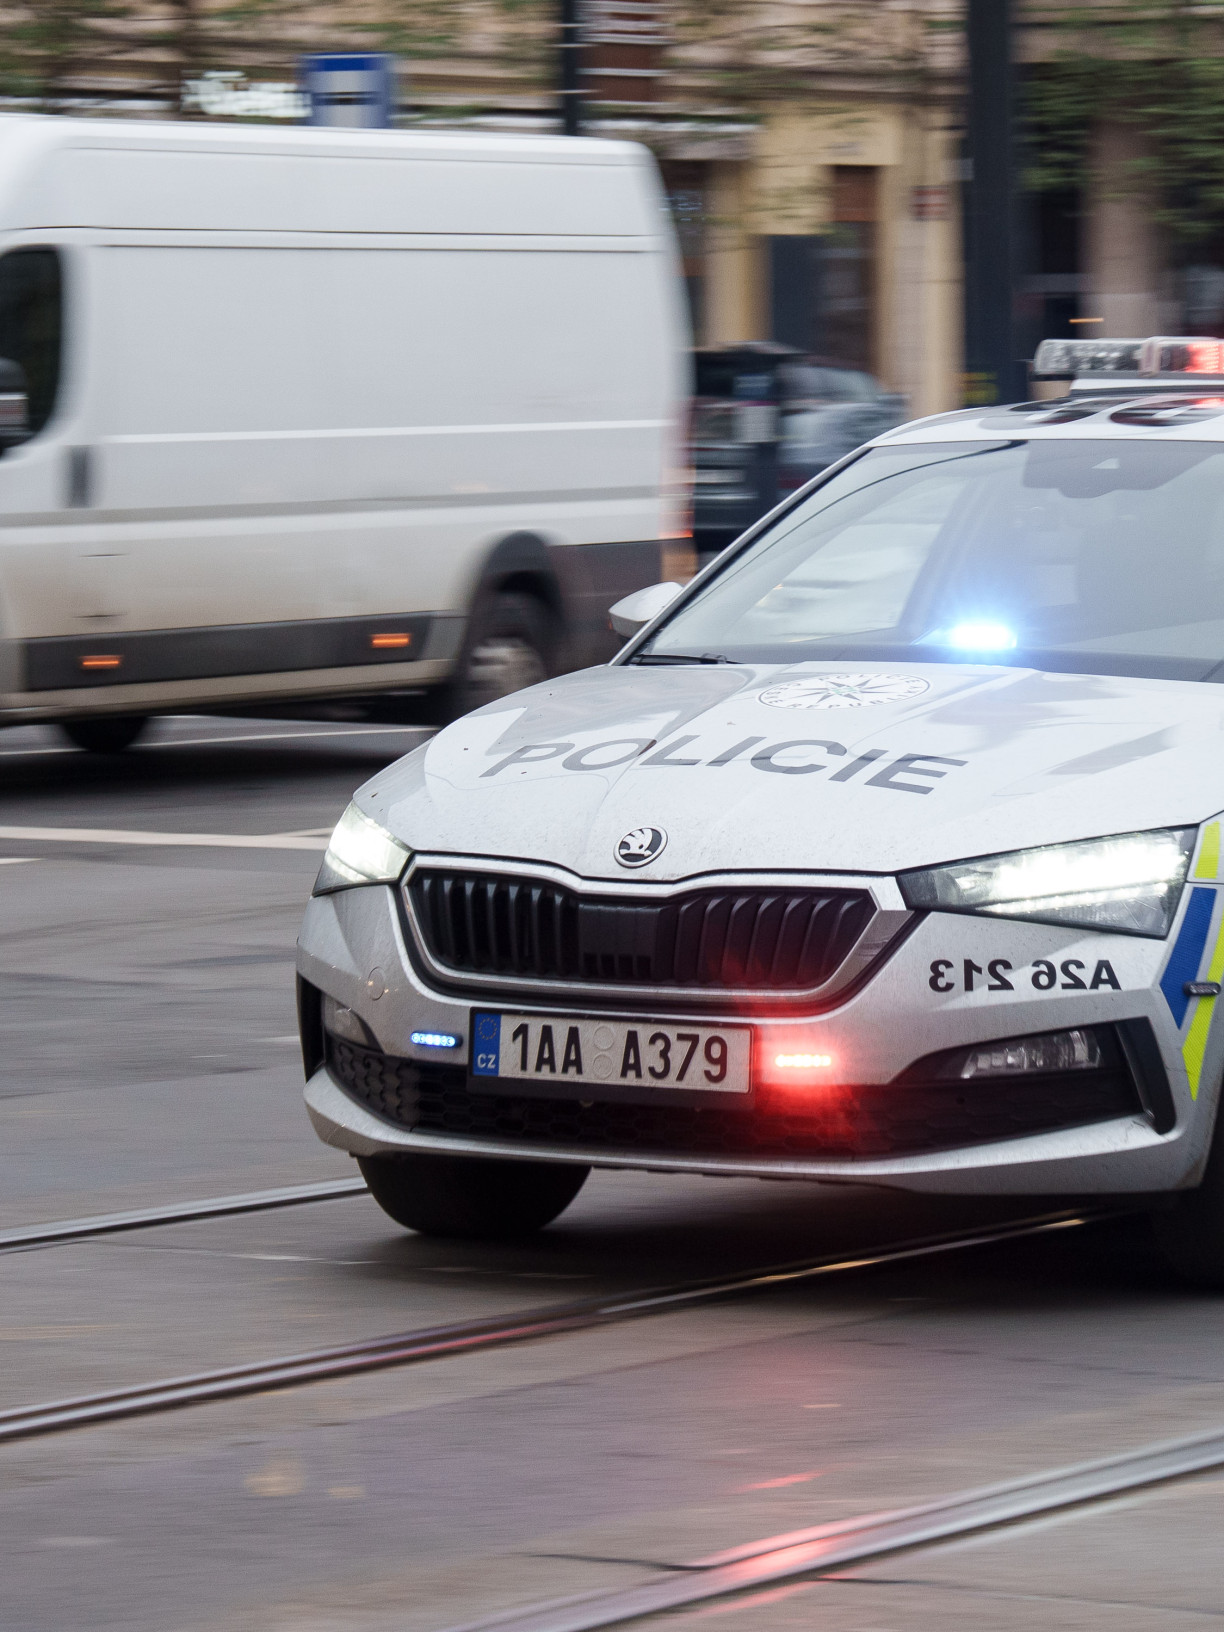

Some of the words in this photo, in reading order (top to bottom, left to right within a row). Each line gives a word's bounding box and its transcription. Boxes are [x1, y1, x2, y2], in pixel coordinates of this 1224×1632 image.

[479, 735, 969, 795] POLICIE
[477, 1053, 496, 1069] CZ
[512, 1023, 583, 1075] 1AA
[620, 1030, 728, 1084] A379
